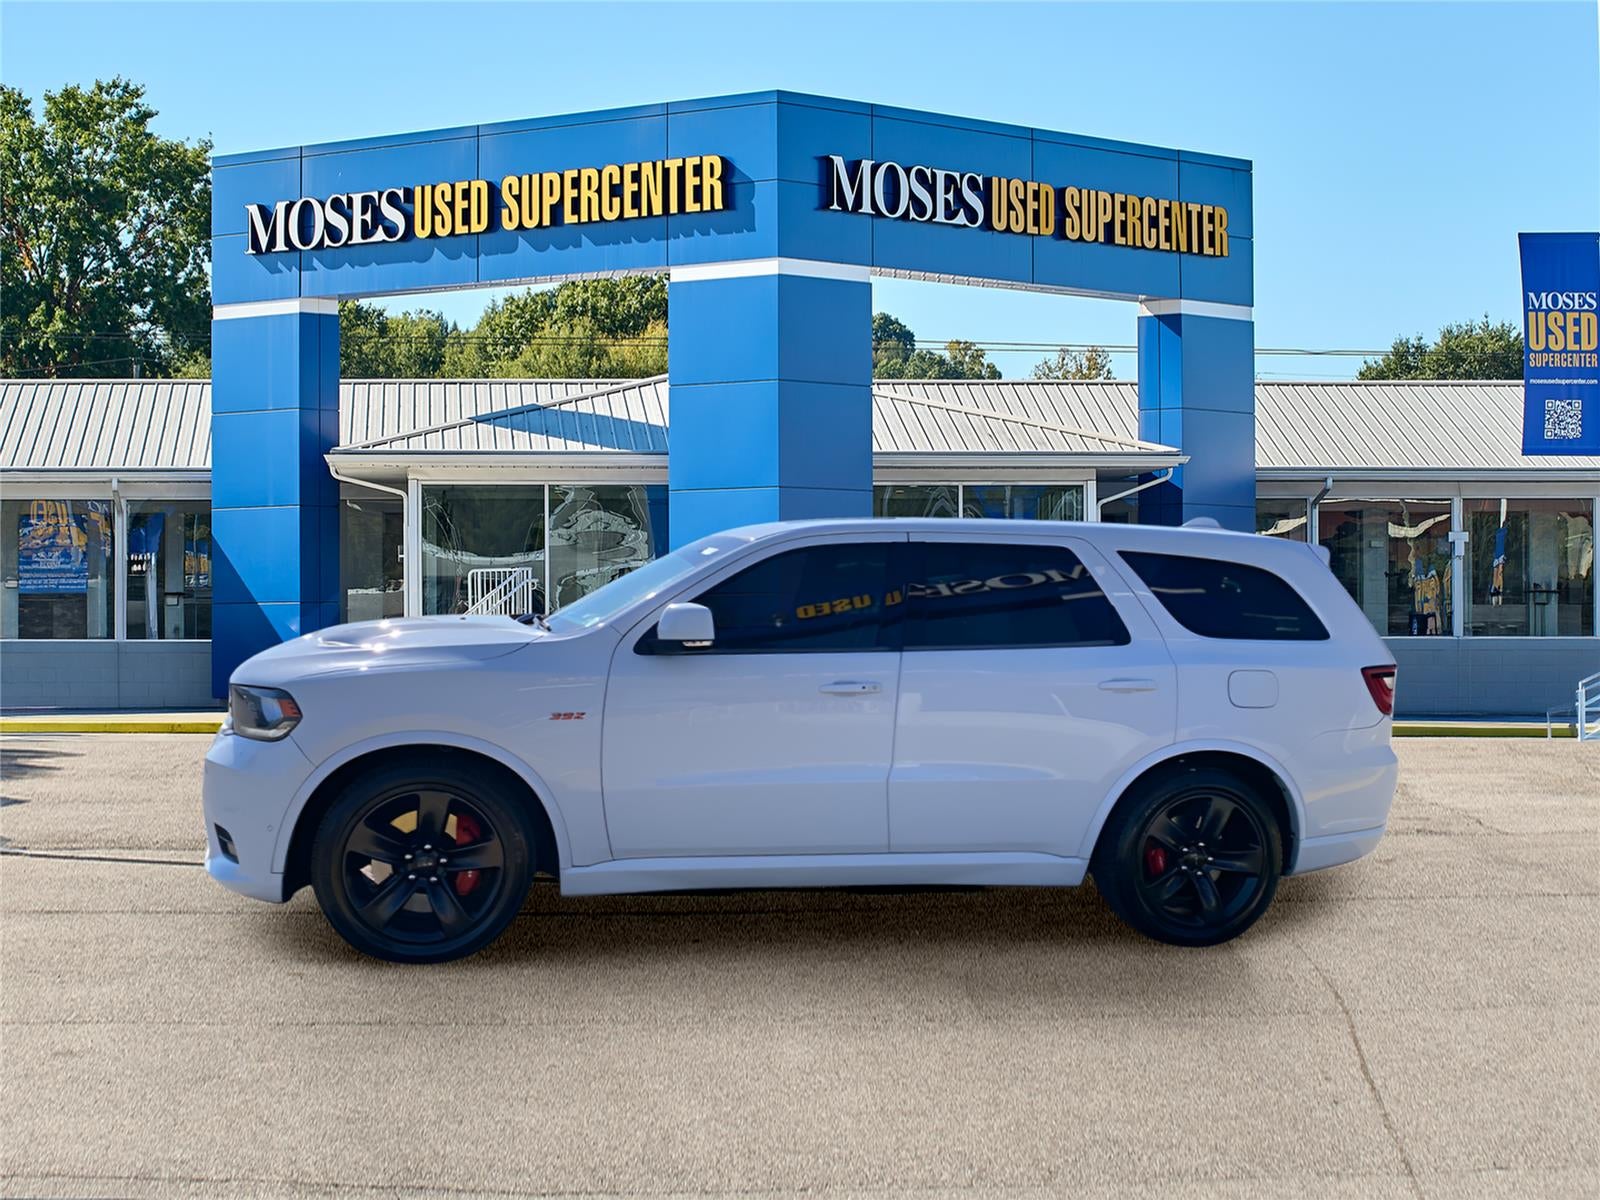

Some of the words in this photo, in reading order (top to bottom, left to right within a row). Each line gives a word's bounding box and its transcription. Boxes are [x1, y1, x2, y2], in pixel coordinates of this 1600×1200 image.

[244, 187, 410, 255] MOSES
[413, 179, 489, 240] USED
[500, 154, 724, 232] SUPERCENTER
[828, 154, 984, 229] MOSES
[991, 176, 1056, 237] USED
[1064, 186, 1229, 257] SUPERCENTER
[1527, 291, 1597, 311] MOSES
[1528, 311, 1598, 351] USED
[1529, 352, 1598, 368] SUPERCENTER
